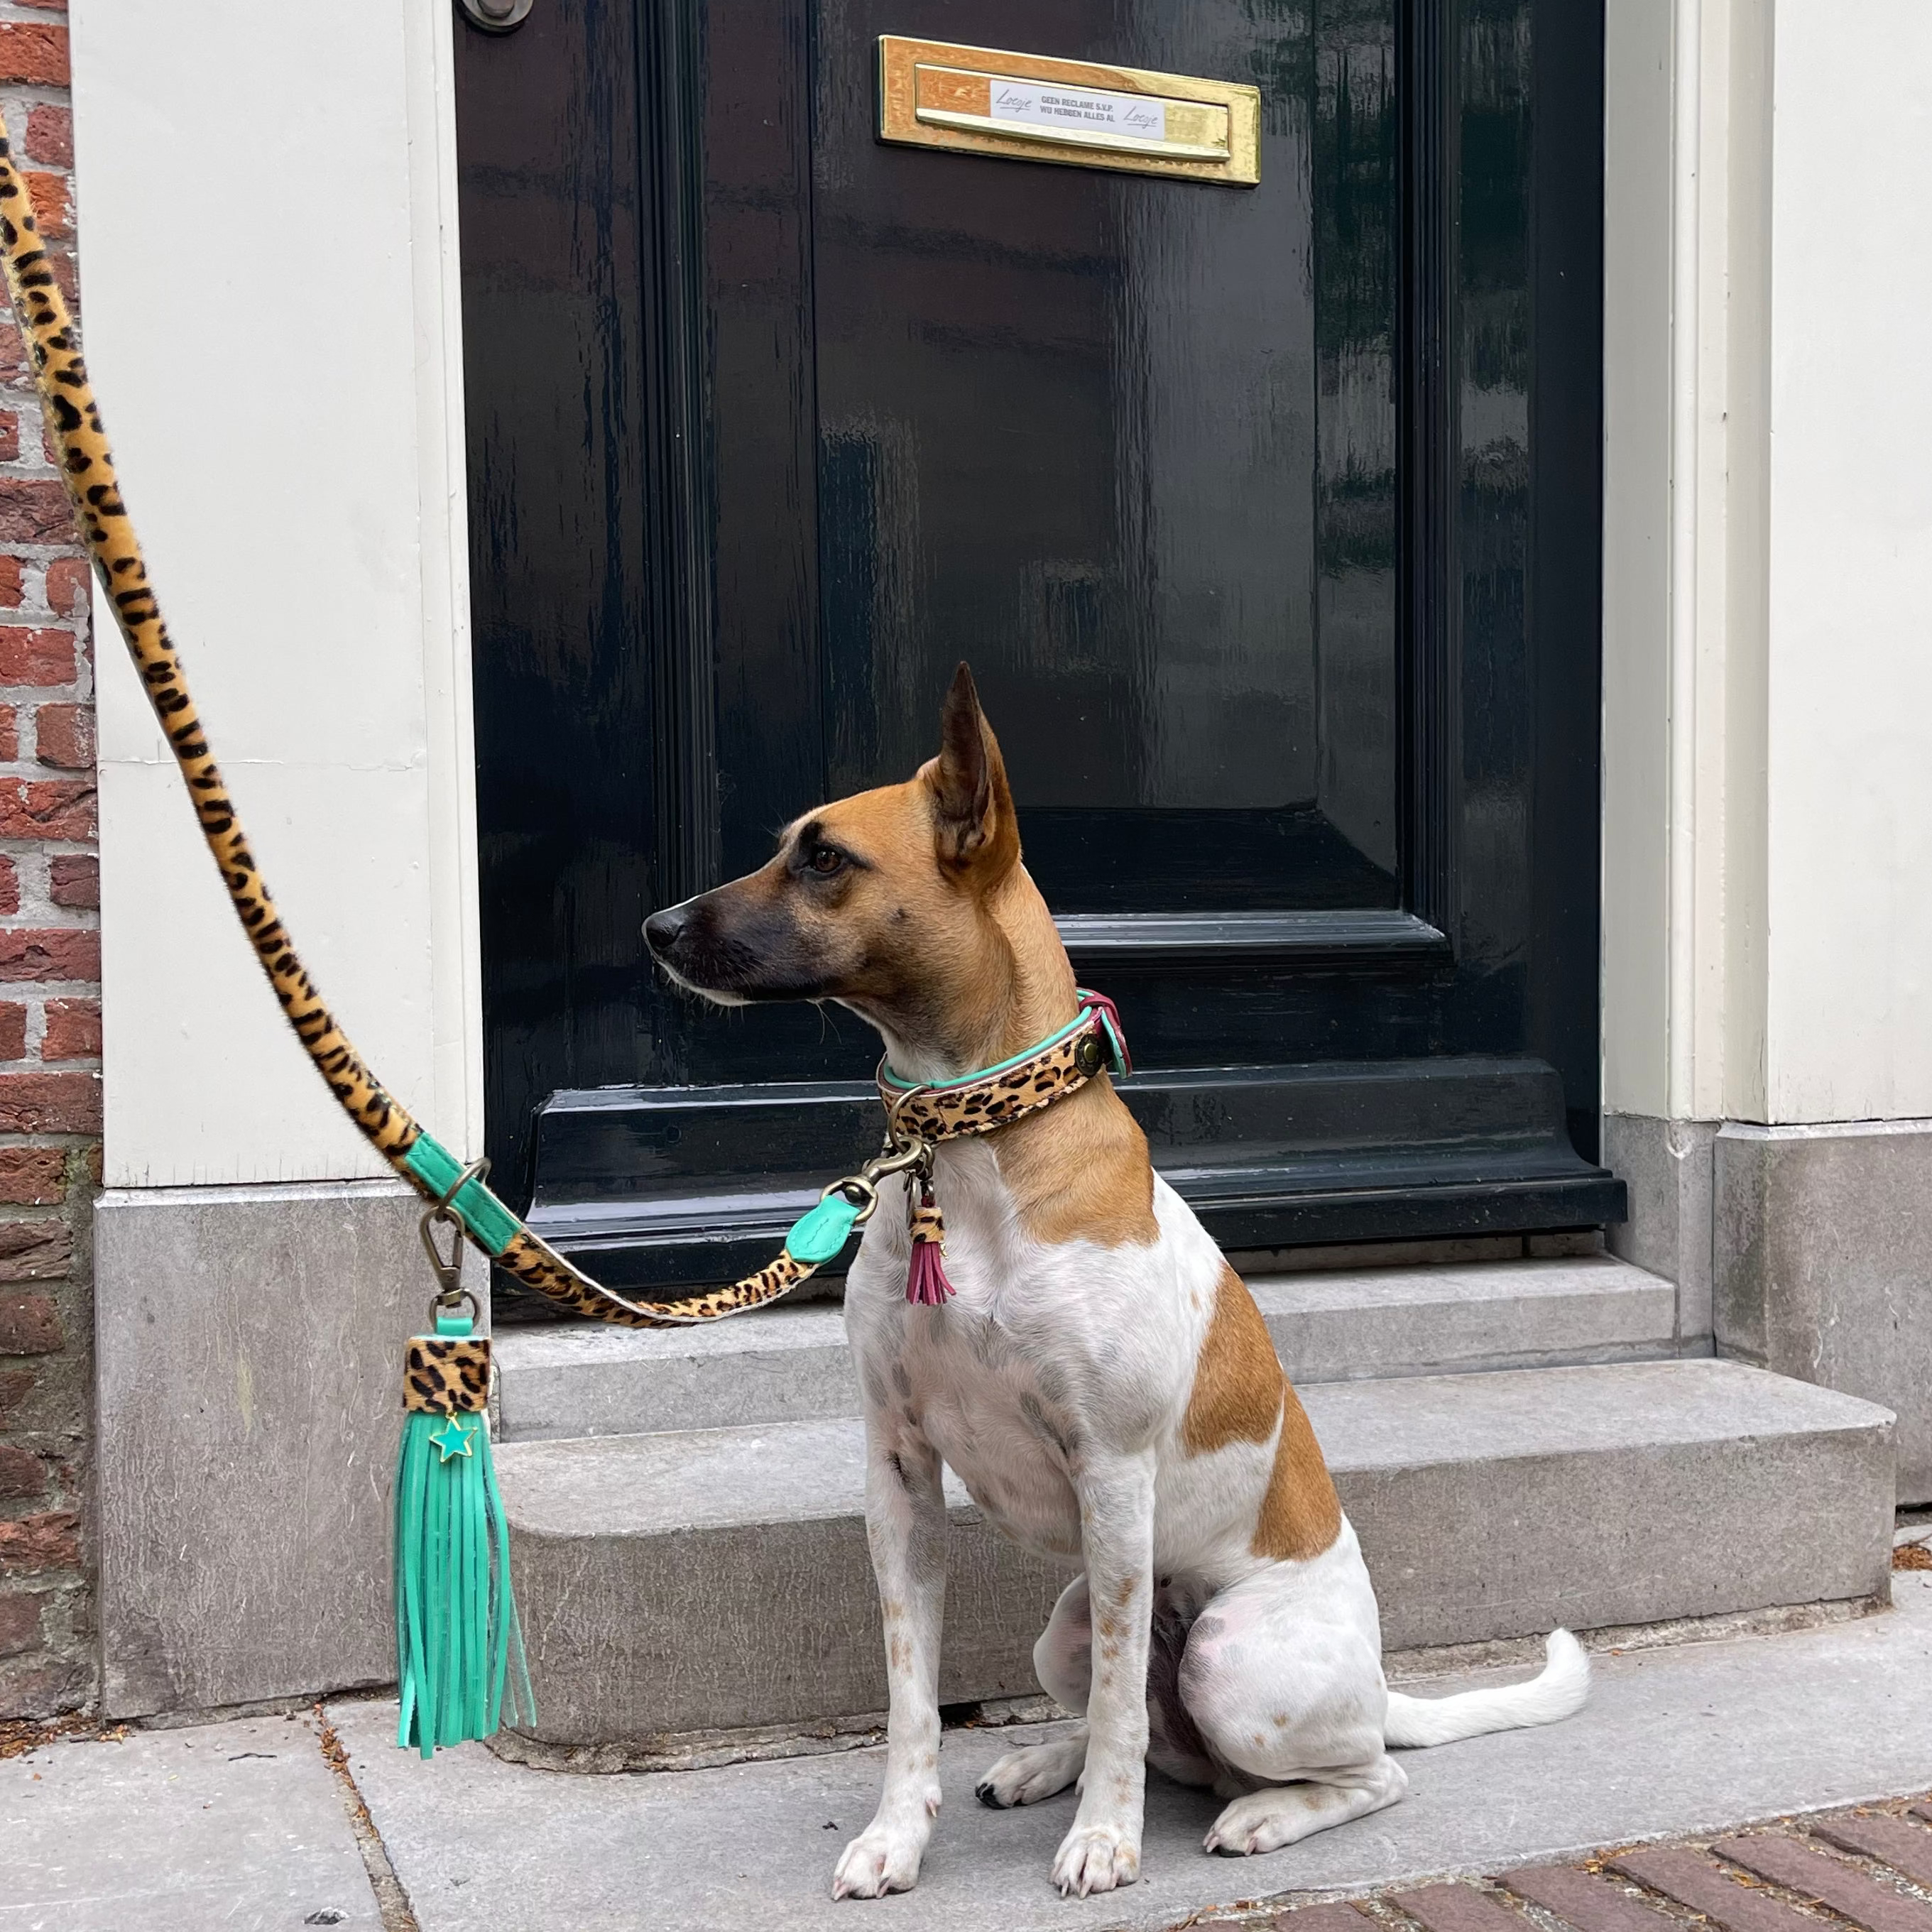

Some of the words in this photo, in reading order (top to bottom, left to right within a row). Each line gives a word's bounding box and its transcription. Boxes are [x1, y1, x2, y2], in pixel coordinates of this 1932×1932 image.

[1041, 96, 1060, 105] GEEN
[1061, 99, 1094, 109] RECLAME
[1096, 104, 1113, 112] S.V.P.
[1054, 107, 1082, 118] HEBBEN
[1084, 111, 1105, 121] ALLES
